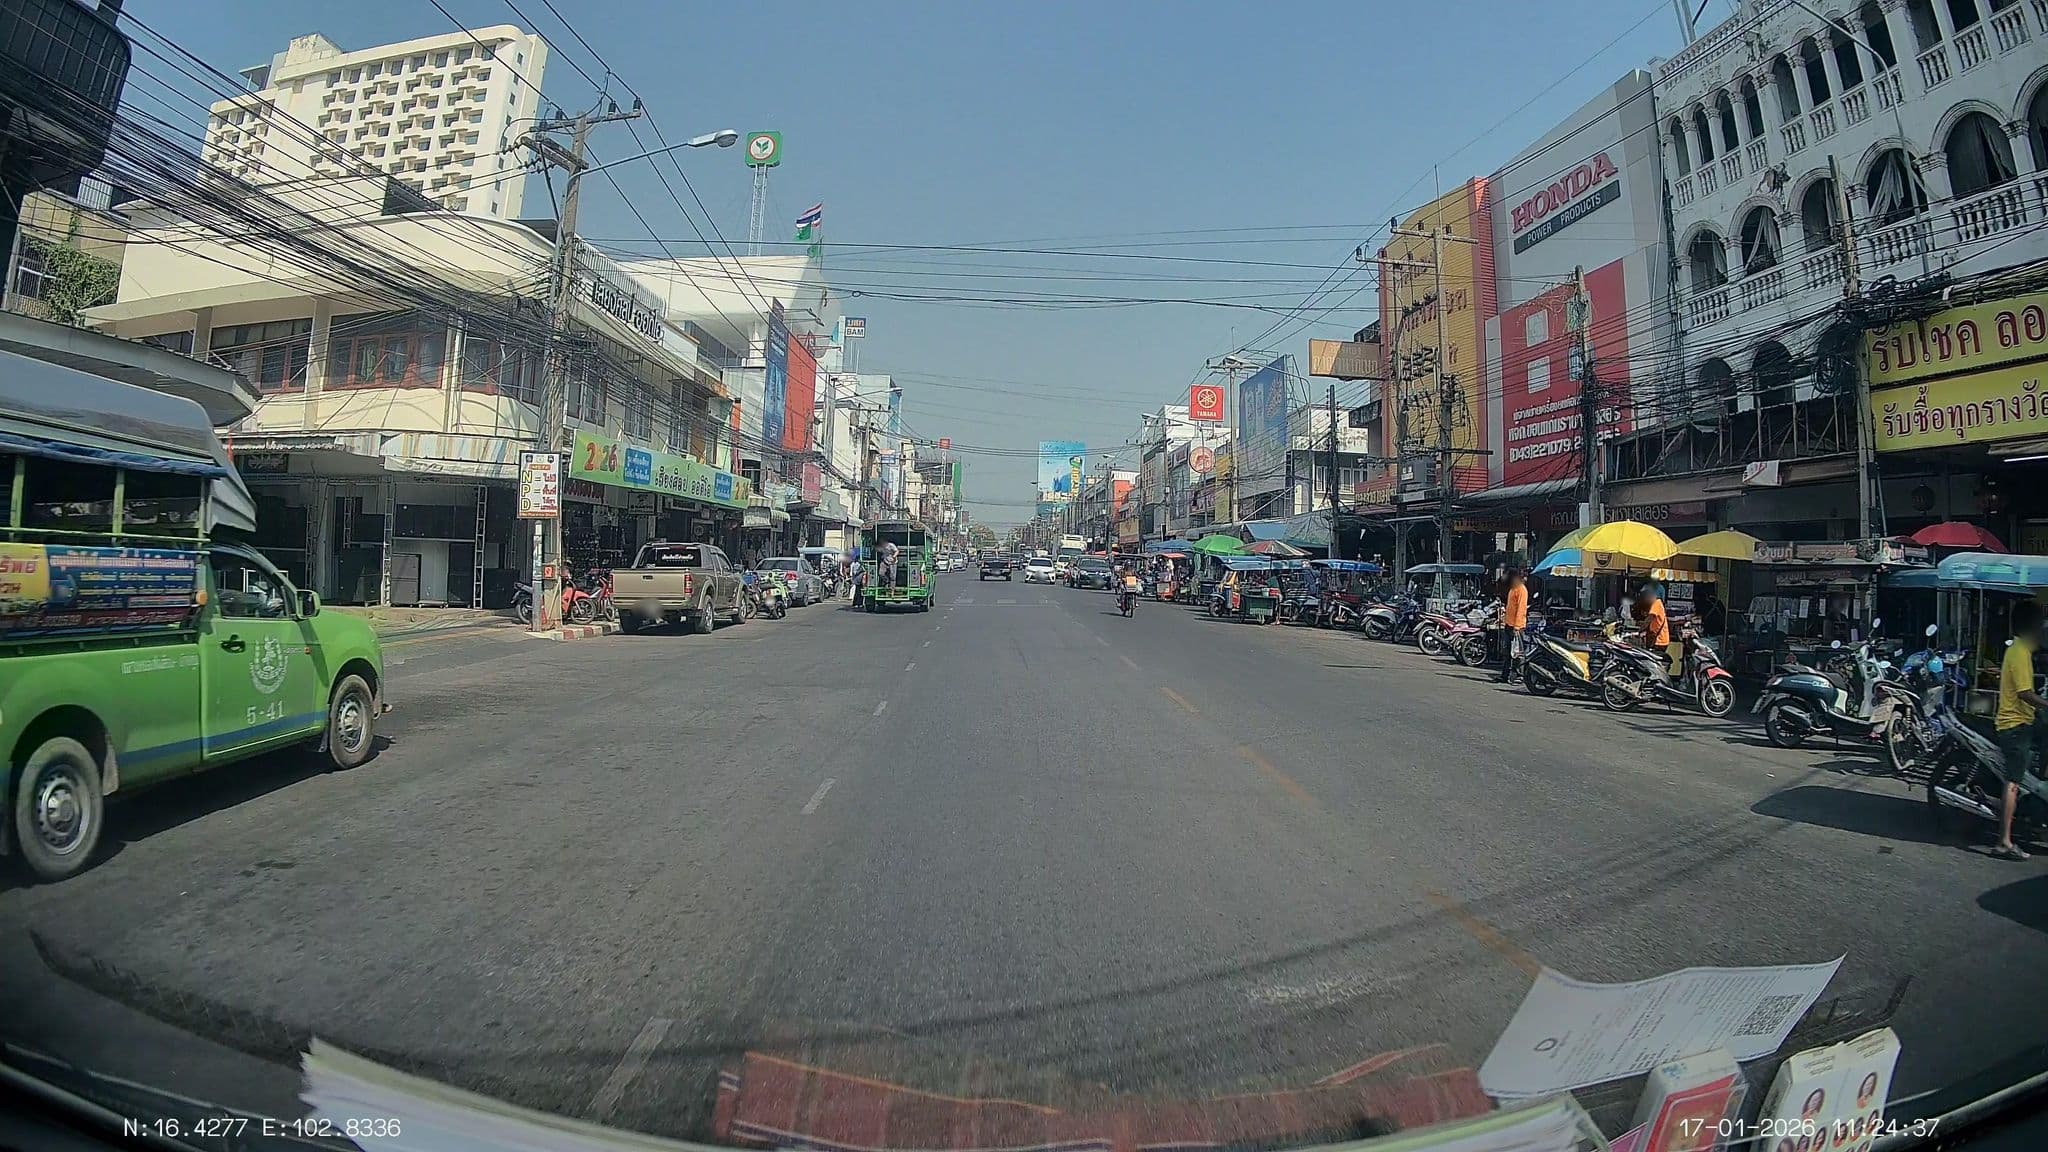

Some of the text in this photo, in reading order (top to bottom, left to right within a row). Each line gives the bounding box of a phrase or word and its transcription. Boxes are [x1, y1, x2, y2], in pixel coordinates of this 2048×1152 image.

[1511, 152, 1618, 234] HONDA
[1527, 193, 1601, 245] POWER PRODUCTS
[846, 328, 864, 336] BAM
[1197, 410, 1217, 418] YAMAHA
[522, 470, 533, 483] N
[521, 484, 531, 497] P
[521, 498, 531, 511] D
[246, 700, 285, 725] 5-41
